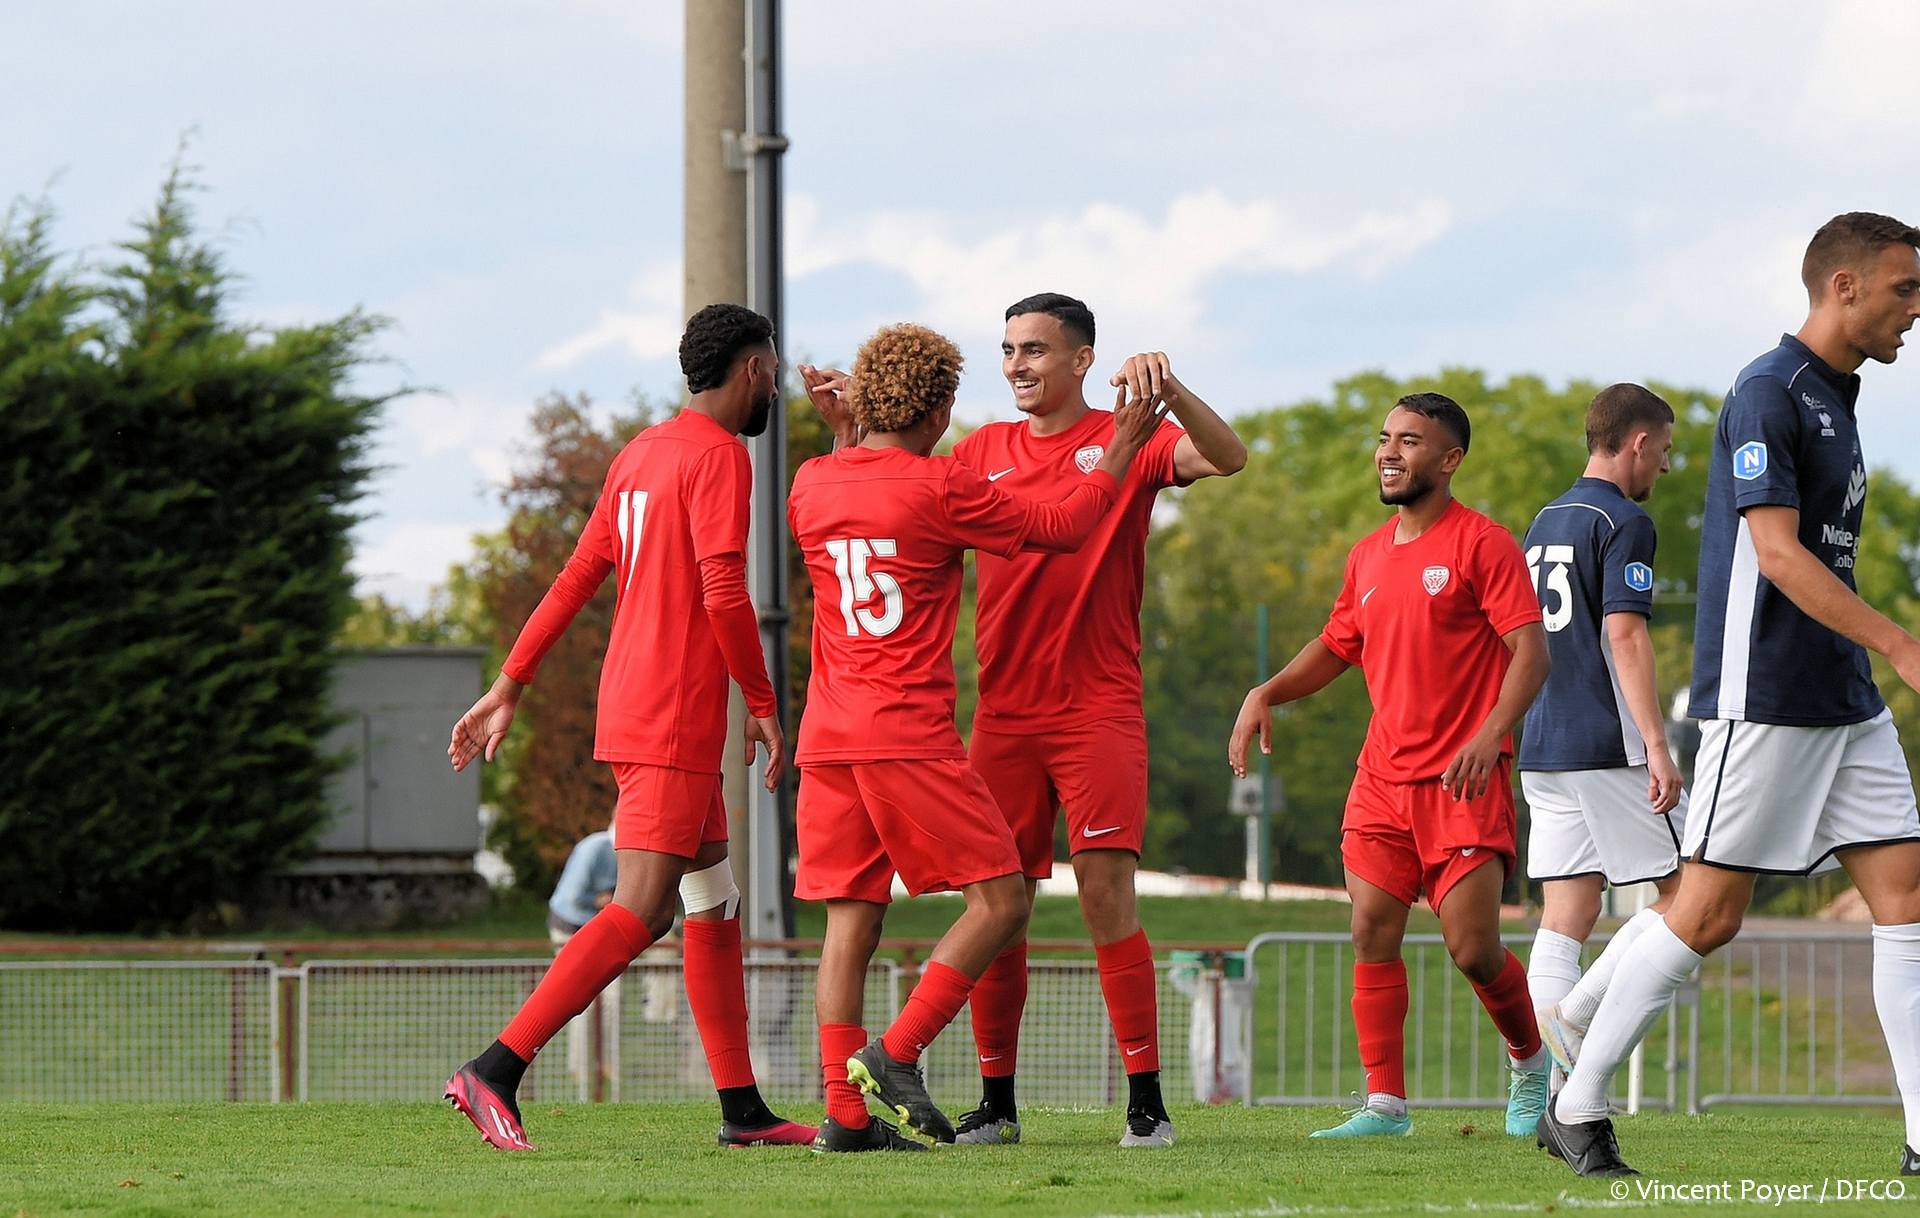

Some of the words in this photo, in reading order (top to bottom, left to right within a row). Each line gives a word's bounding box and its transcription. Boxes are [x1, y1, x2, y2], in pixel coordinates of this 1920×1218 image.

[1744, 448, 1760, 469] N
[617, 490, 649, 591] 11
[1632, 567, 1645, 583] N
[826, 538, 904, 637] 15
[1525, 545, 1574, 633] 13
